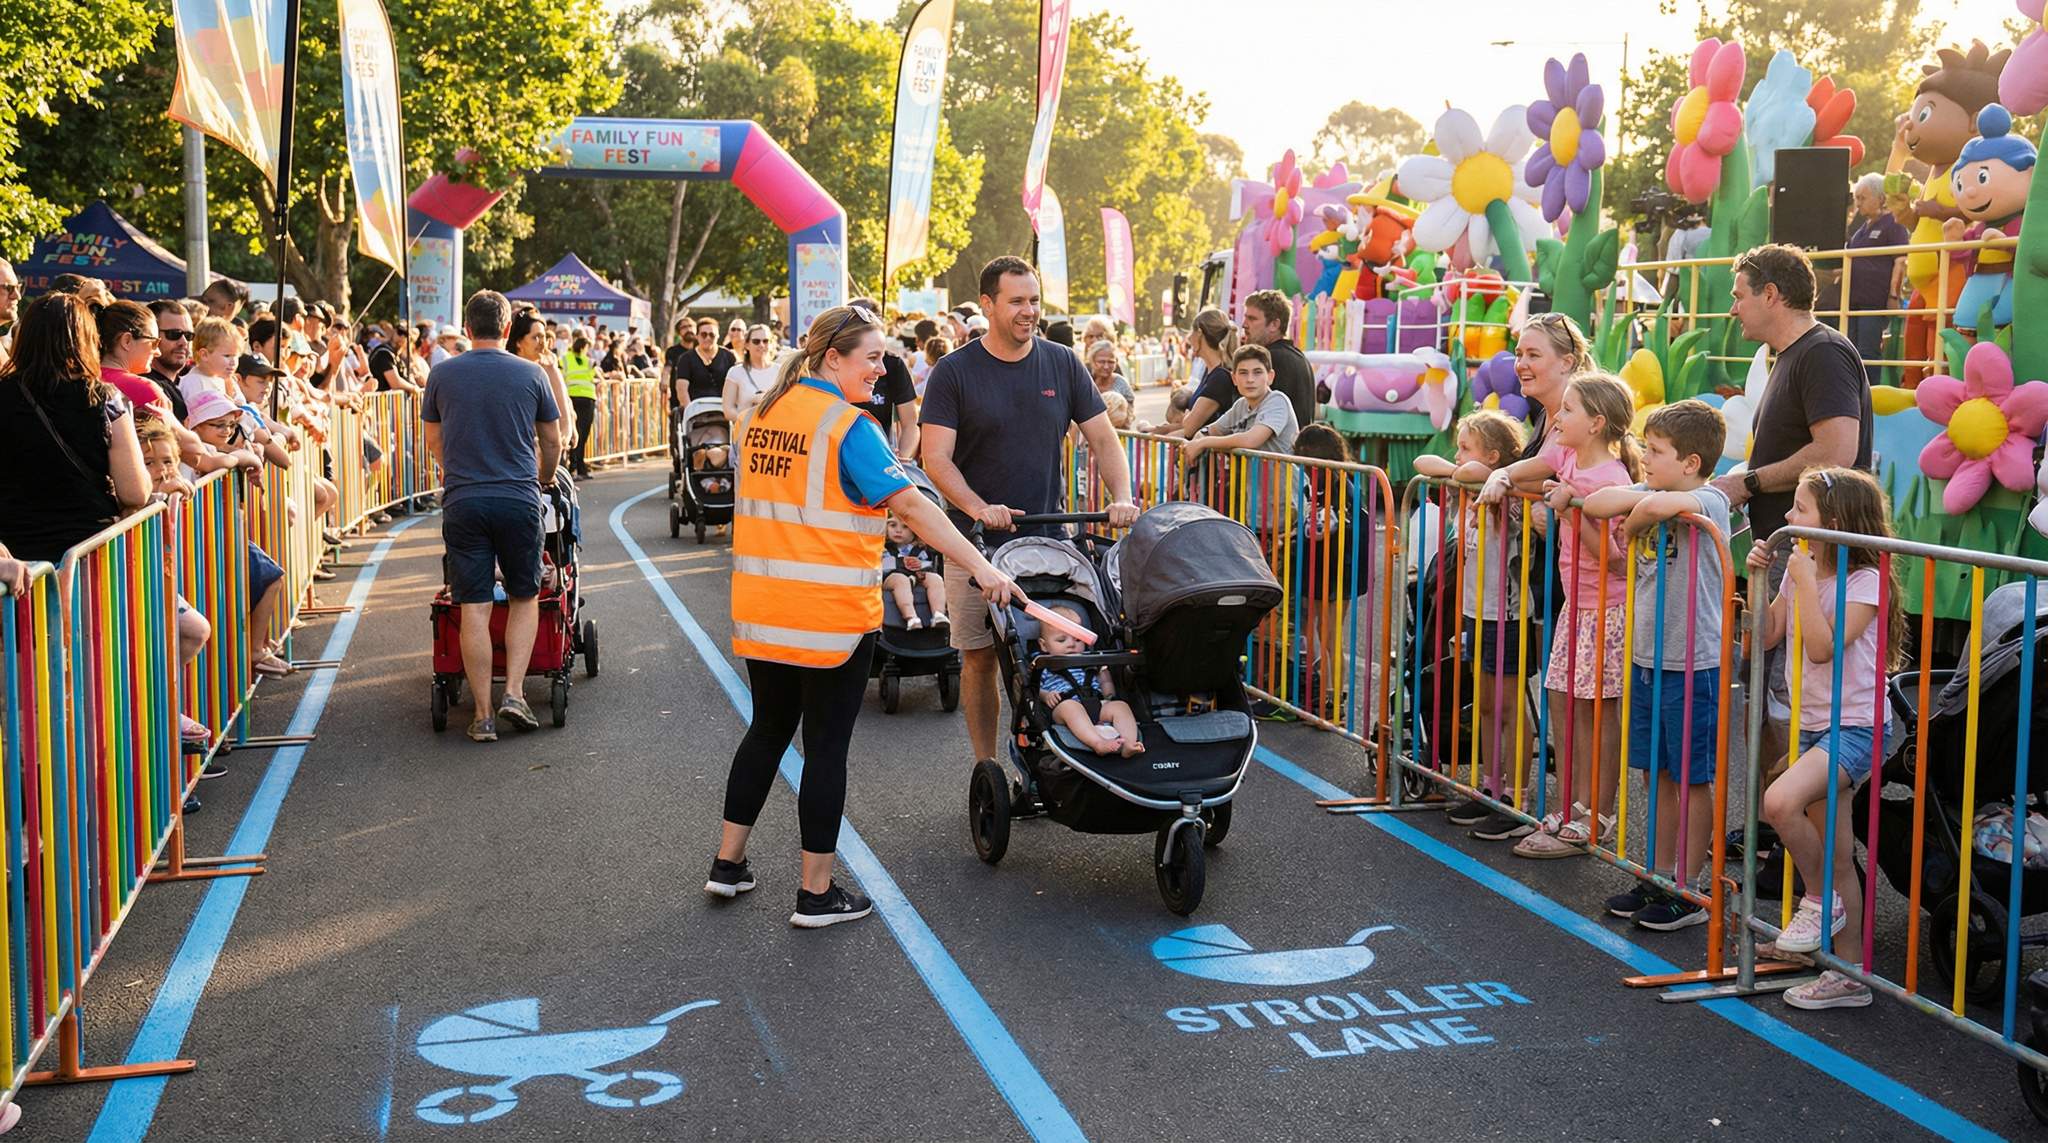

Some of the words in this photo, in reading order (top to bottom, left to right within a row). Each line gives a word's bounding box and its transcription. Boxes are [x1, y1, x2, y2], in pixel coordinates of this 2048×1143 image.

[916, 60, 936, 77] FUN
[913, 77, 936, 93] FEST
[571, 129, 639, 145] FAMILY
[646, 131, 683, 146] FUN
[604, 148, 650, 164] FEST
[56, 243, 107, 257] FUN
[745, 427, 808, 455] FESTIVAL
[750, 453, 792, 478] STAFF
[1164, 980, 1533, 1034] STROLLER
[1288, 1015, 1496, 1059] LANE
